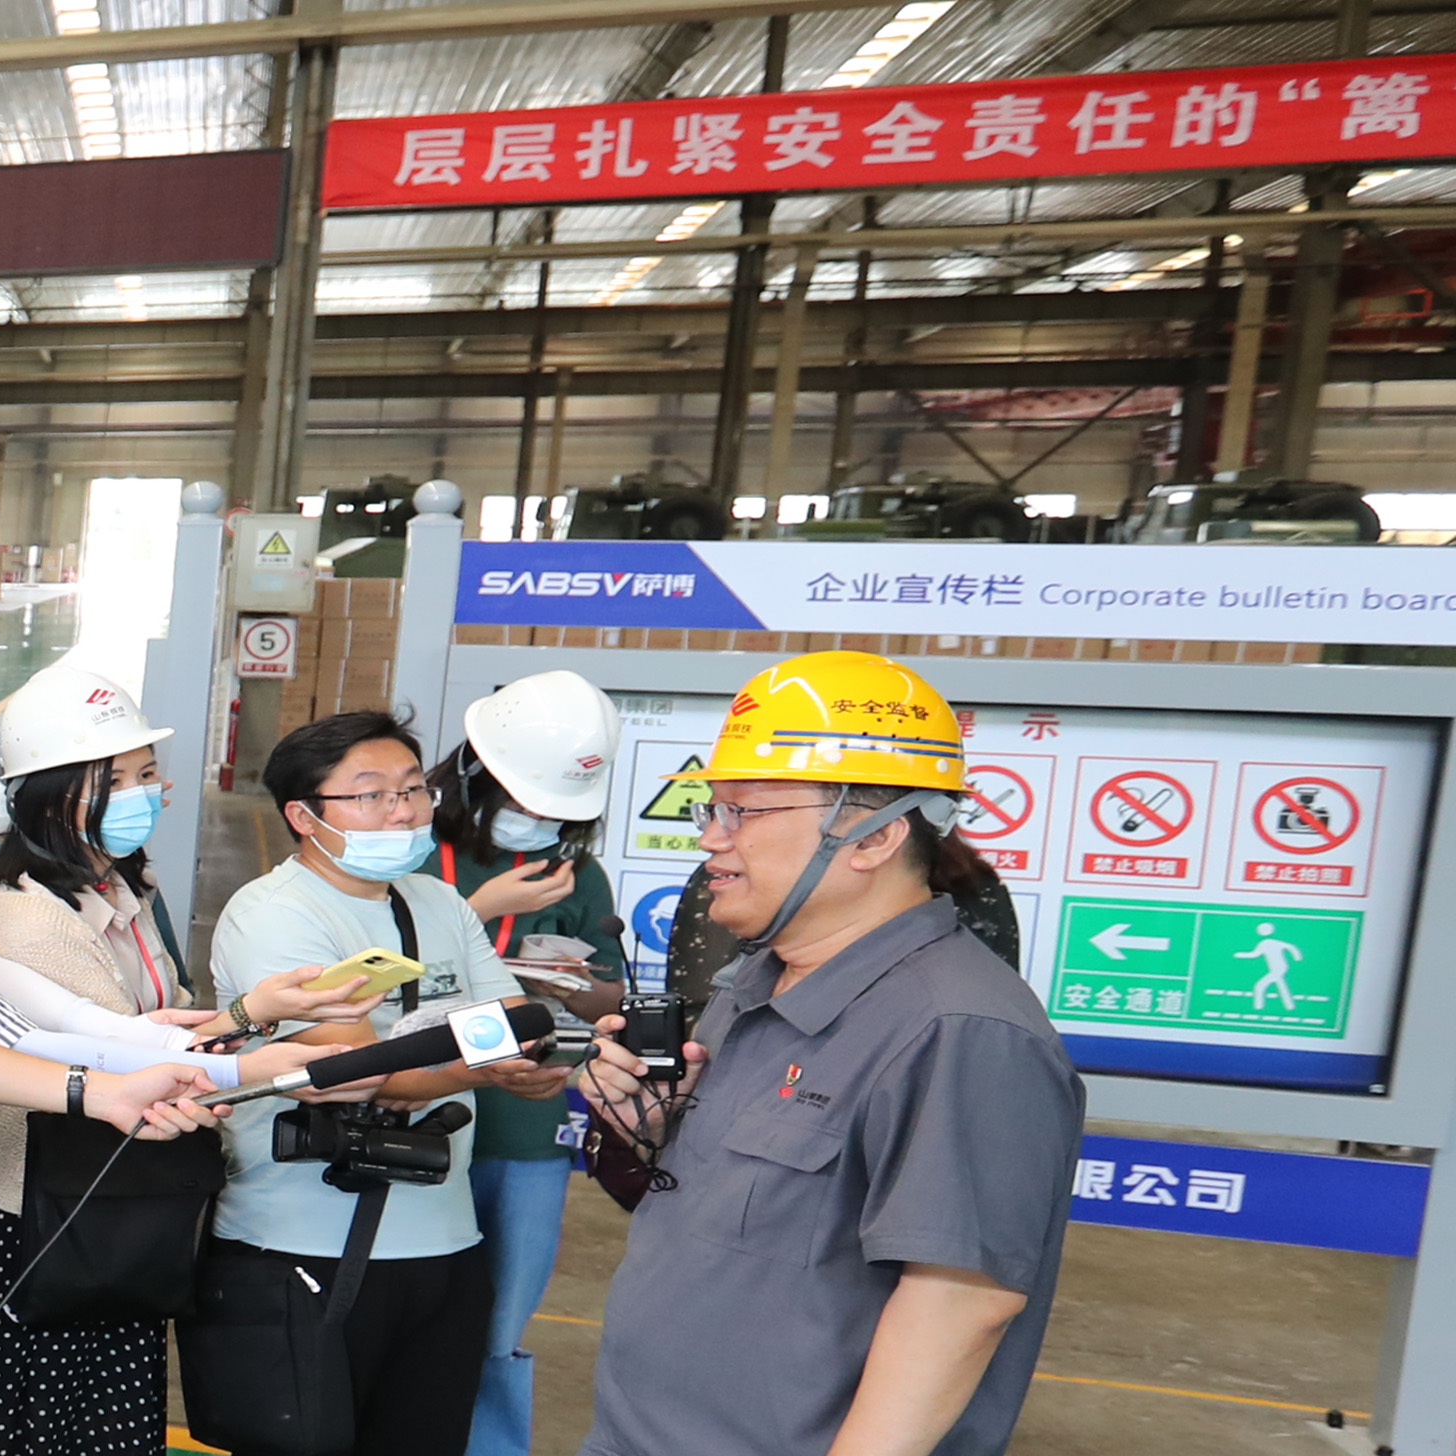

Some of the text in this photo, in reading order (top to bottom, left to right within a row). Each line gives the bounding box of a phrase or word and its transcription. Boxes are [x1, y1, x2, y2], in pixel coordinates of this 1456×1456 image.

[393, 71, 1432, 186] 层层扎紧安全责任的“篱
[806, 571, 1025, 606] 企业宣传栏
[1039, 583, 1207, 612] Corporate
[1218, 584, 1349, 609] bulletin
[259, 631, 276, 651] 5
[830, 698, 930, 721] 安全监督
[1092, 856, 1178, 877] 禁止吸烟
[1254, 864, 1343, 885] 禁止拍照
[1063, 982, 1185, 1015] 安全通道
